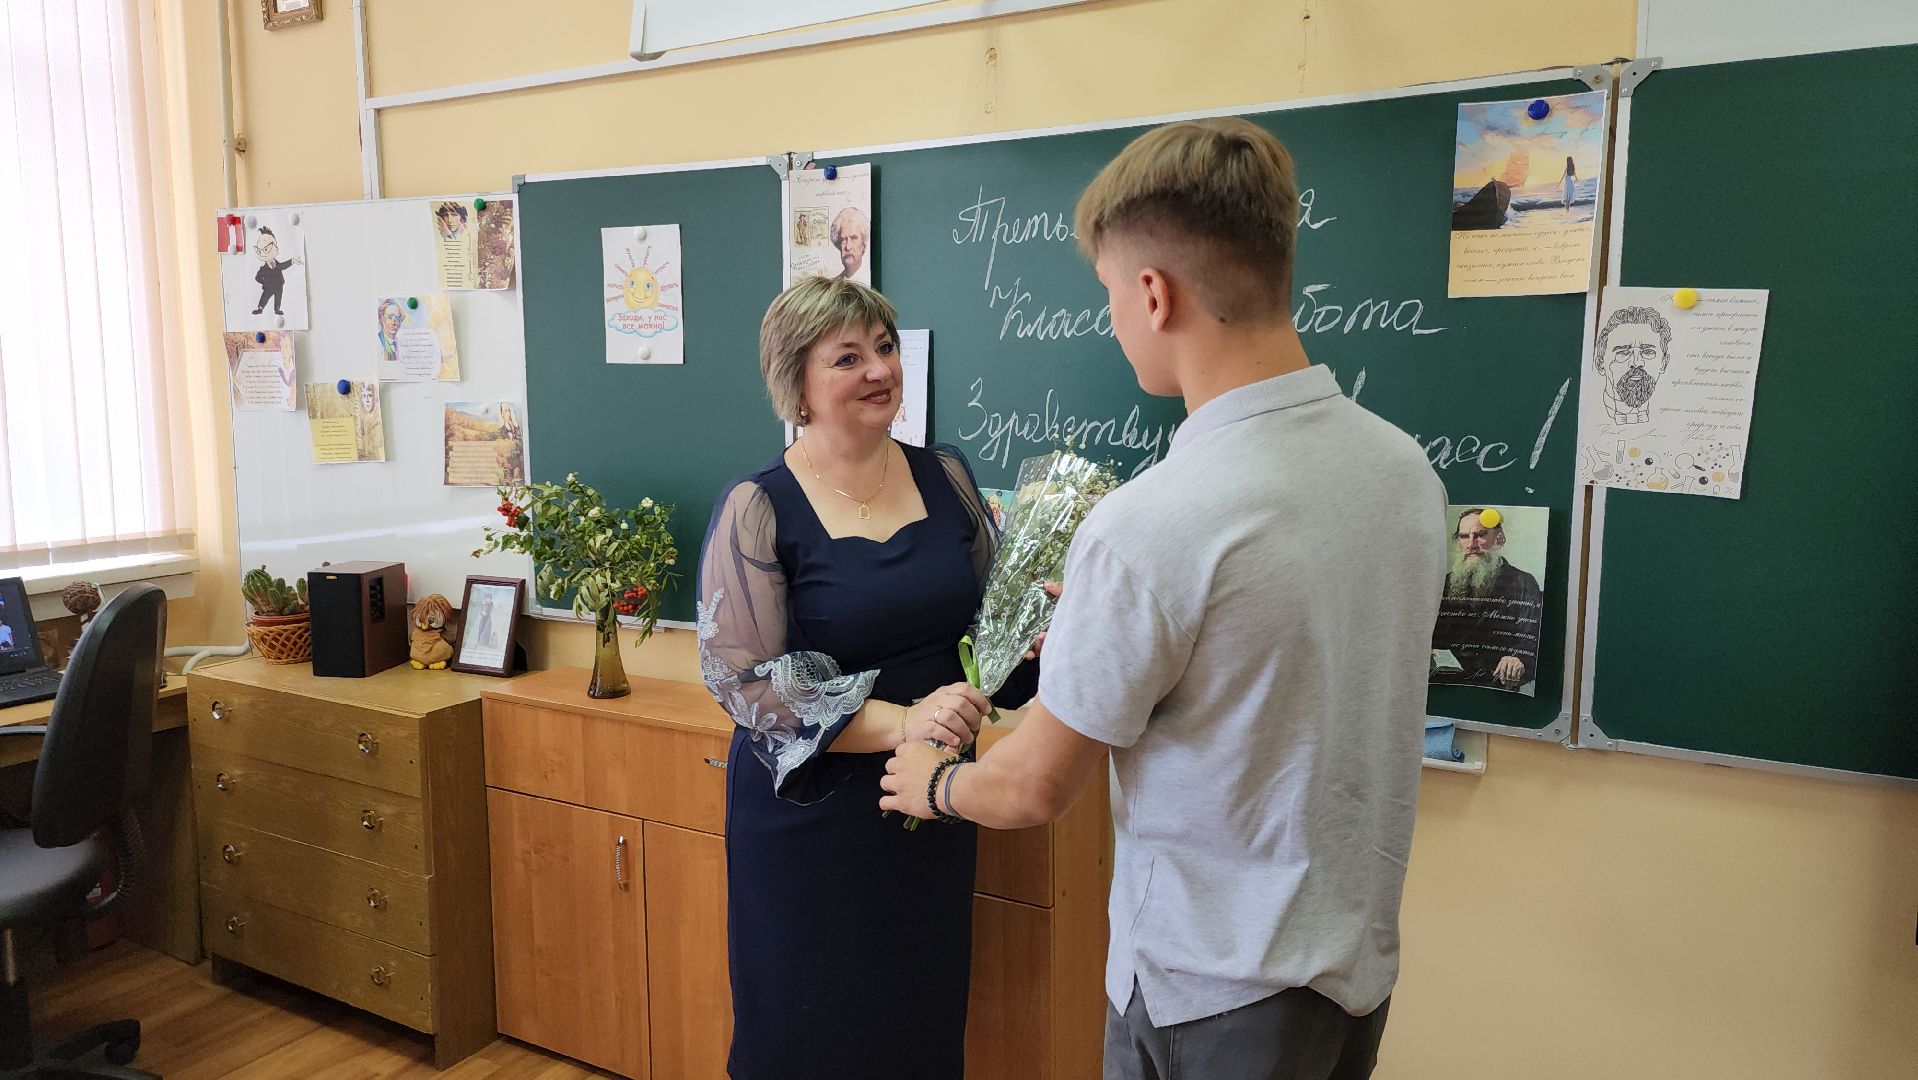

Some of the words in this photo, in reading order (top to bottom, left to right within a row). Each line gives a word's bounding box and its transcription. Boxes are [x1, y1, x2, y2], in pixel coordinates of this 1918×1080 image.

[952, 185, 1080, 290] Треть
[638, 321, 665, 330] можно!
[1292, 284, 1448, 335] бота
